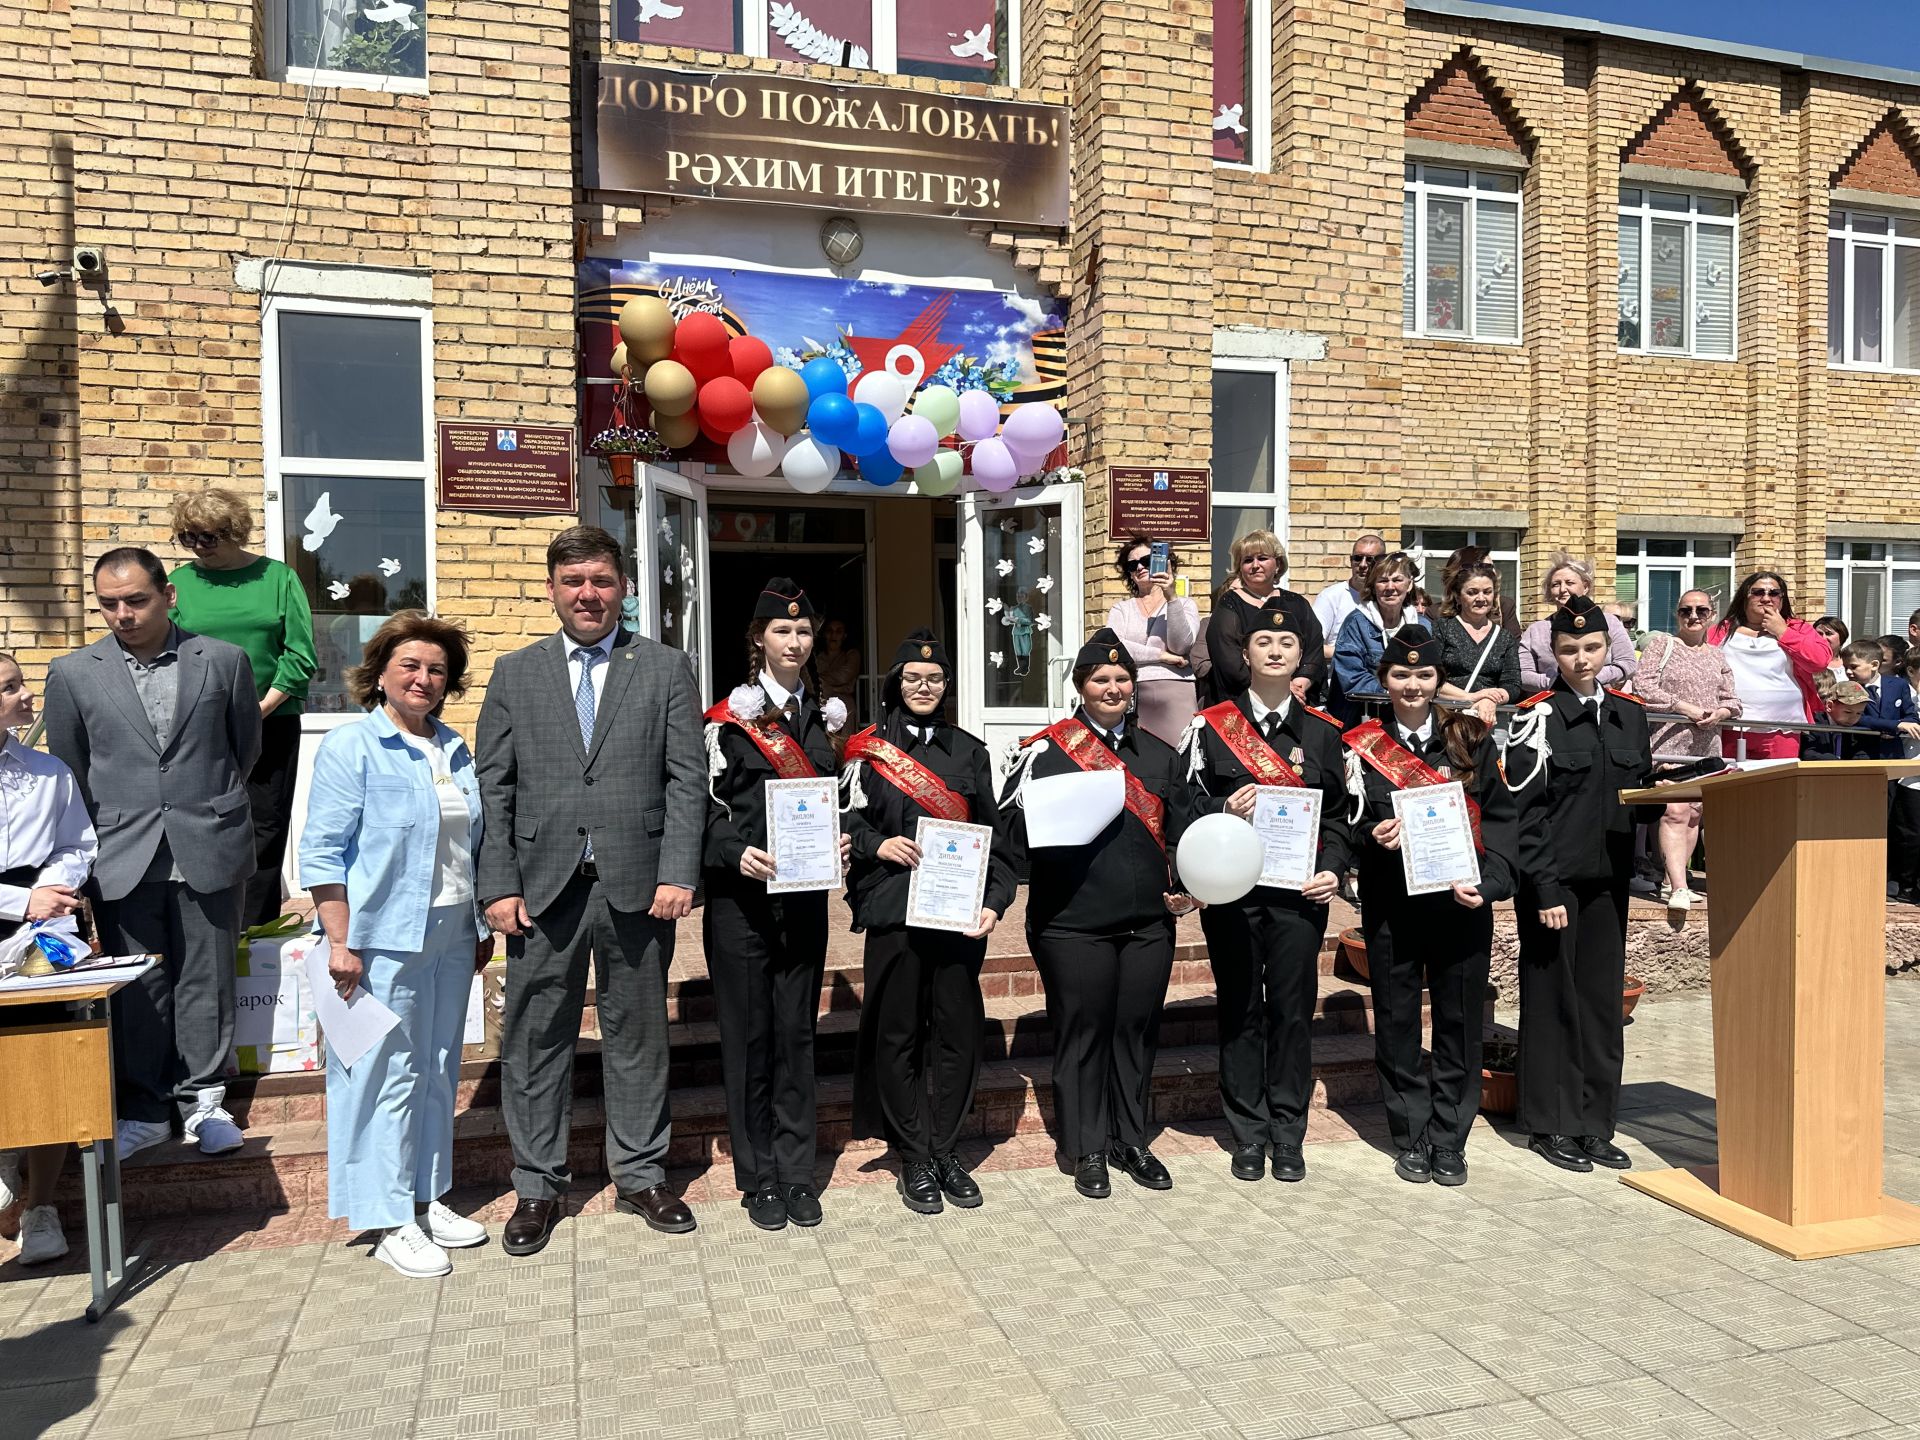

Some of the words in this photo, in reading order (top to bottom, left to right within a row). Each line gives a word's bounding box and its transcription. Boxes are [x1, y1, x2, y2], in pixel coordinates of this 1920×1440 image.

[598, 75, 747, 118] ДОБРО
[761, 88, 1060, 147] ПОЖАЛОВАТЬ!
[664, 151, 821, 195] РӘХИМ
[835, 164, 1001, 209] ИТЕГЕЗ!
[792, 813, 815, 821] ДИПЛОМ
[938, 852, 963, 861] ДИПЛОМ
